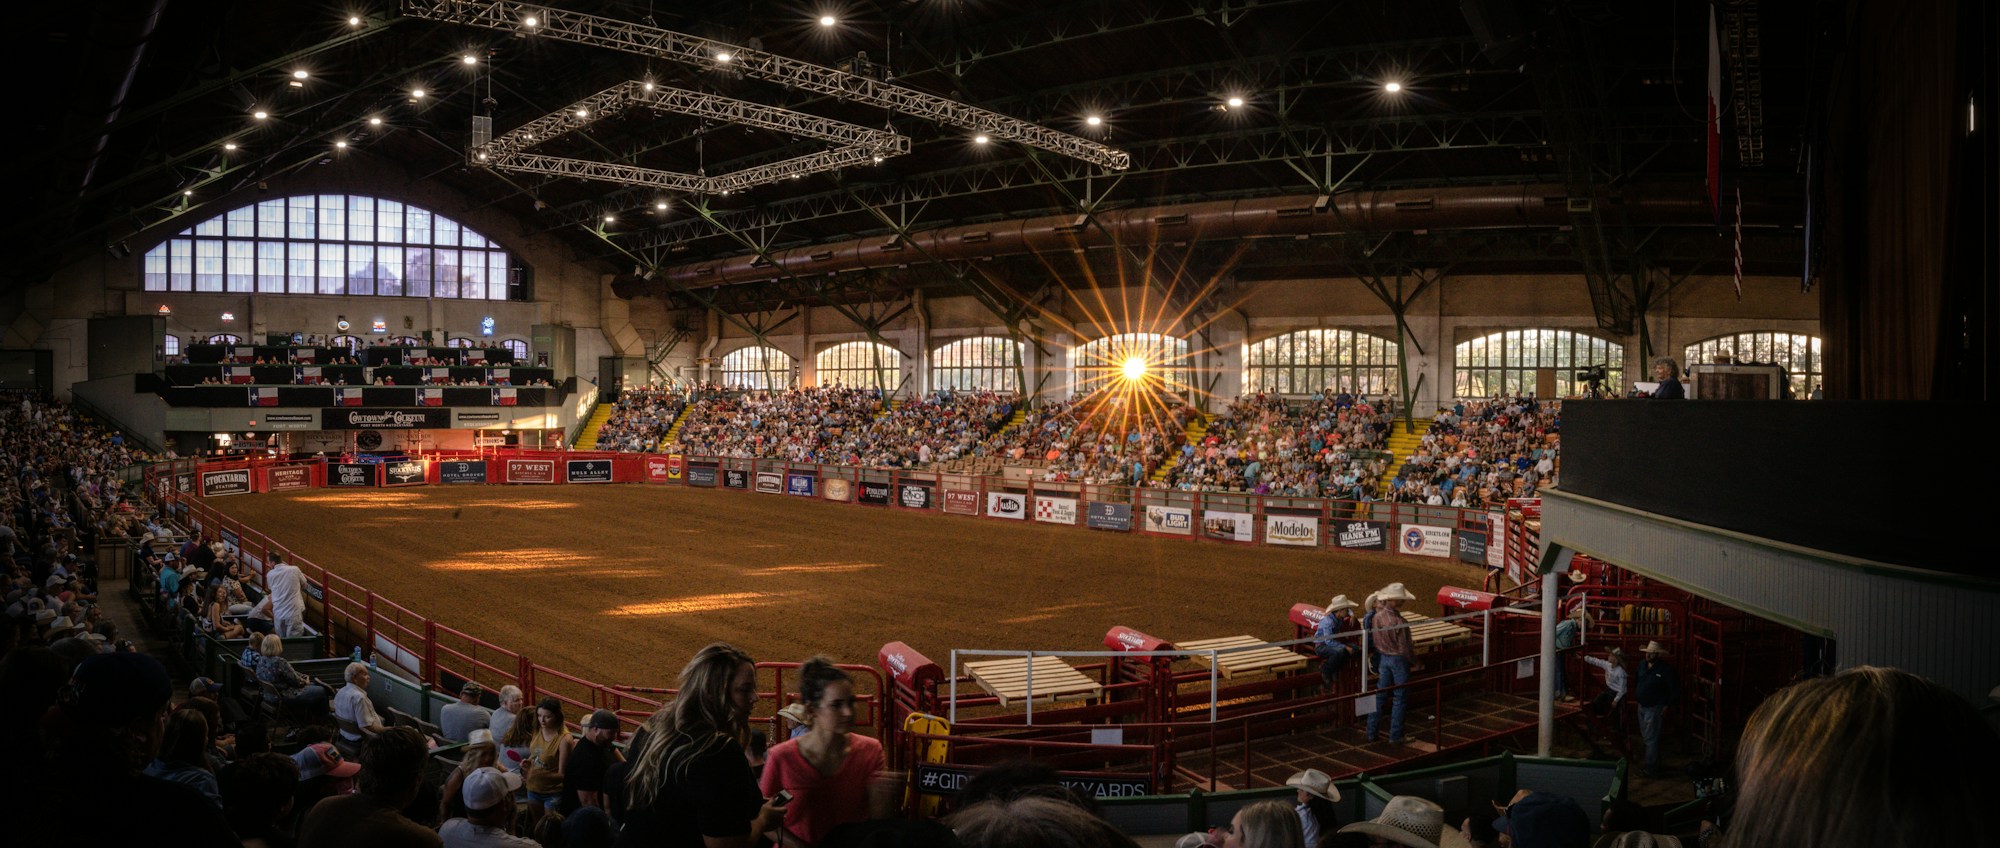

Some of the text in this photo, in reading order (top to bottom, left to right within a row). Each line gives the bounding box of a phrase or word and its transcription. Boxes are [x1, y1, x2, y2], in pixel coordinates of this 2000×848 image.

[274, 469, 304, 477] HERITAGE
[205, 473, 247, 487] STOCKYARDS
[957, 493, 975, 501] WEST
[1167, 519, 1188, 528] LIGHT
[1274, 521, 1309, 537] Modelo
[1347, 521, 1369, 533] 92.1
[1341, 529, 1378, 541] HANK FM
